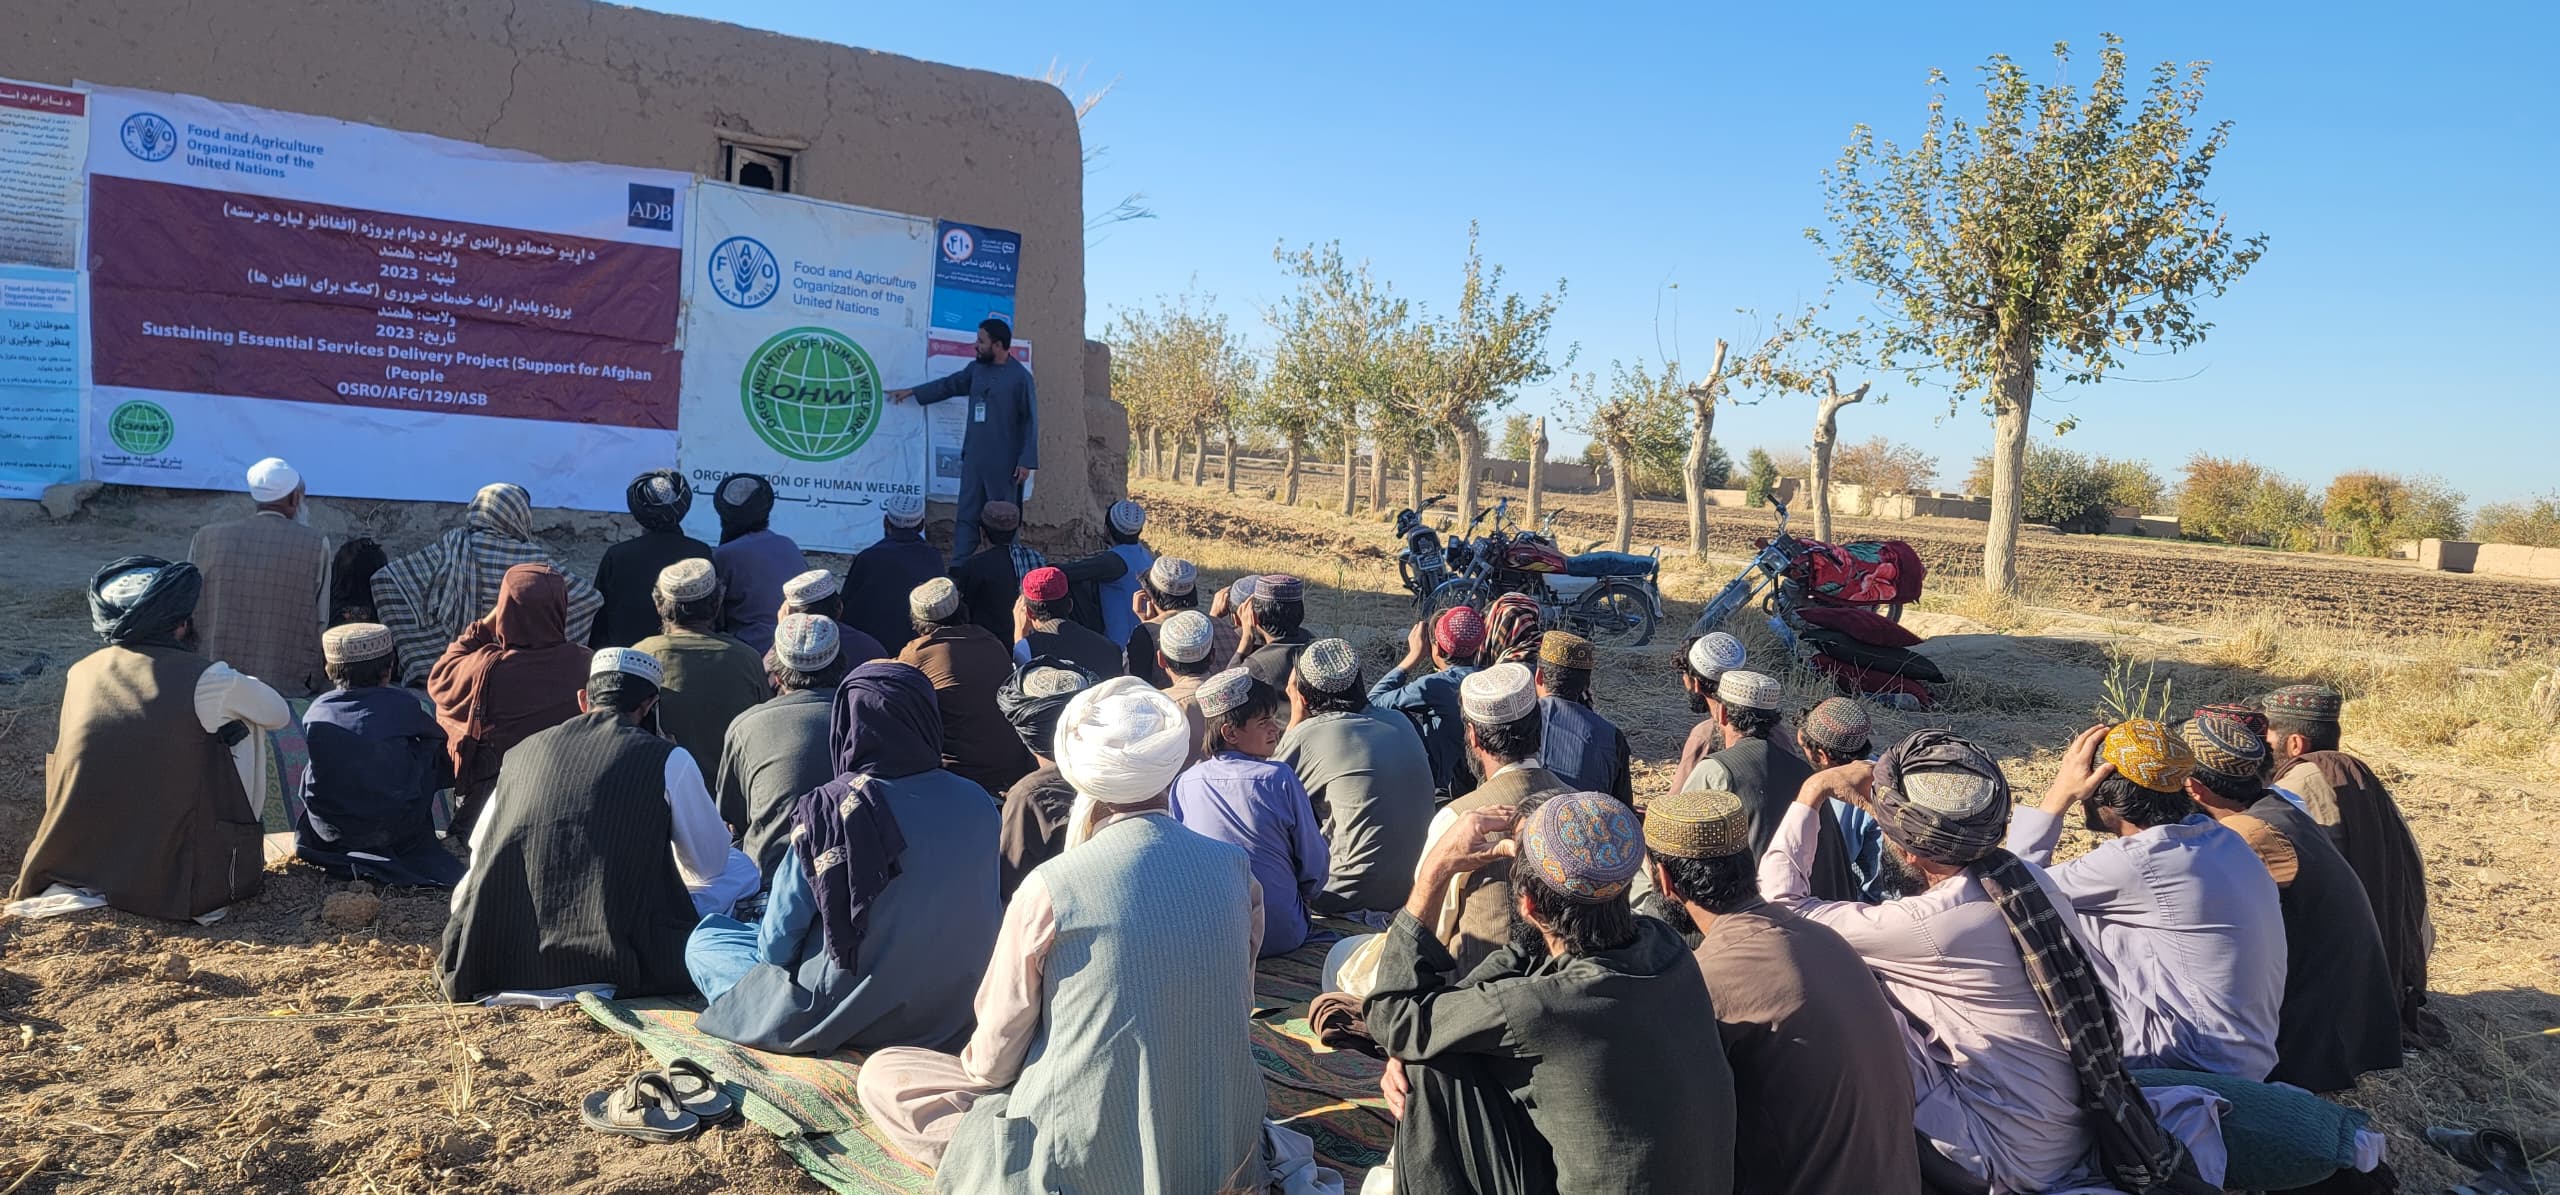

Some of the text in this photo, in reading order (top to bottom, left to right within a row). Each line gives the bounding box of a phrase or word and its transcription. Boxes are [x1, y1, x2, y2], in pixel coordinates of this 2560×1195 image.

[187, 123, 324, 156] Food and Agriculture
[187, 139, 314, 169] Organization of the
[187, 154, 286, 178] United Nations
[630, 200, 672, 221] ADB
[361, 221, 394, 241] پروژه
[398, 226, 426, 242] دوام
[429, 232, 437, 242] د
[379, 245, 415, 260] هلمند
[515, 239, 555, 257] خدماتو
[588, 252, 596, 261] د
[716, 243, 773, 279] FAO
[271, 273, 306, 288] افغان
[380, 264, 418, 280] 2023
[793, 260, 825, 277] Food
[829, 267, 852, 280] and
[855, 269, 917, 290] Agriculture
[310, 278, 339, 294] برای
[384, 287, 428, 303] ضروری
[715, 278, 773, 303] FIAT PANIS
[793, 277, 905, 304] Organization of the
[431, 289, 474, 306] خدمات
[506, 298, 539, 317] پایدار
[793, 293, 880, 317] United Nations
[377, 305, 414, 320] هلمند
[542, 304, 572, 320] پروژه
[376, 324, 456, 346] تاریخ: 2023
[142, 321, 652, 383] Sustaining Essential Services Delivery Project (Support for Afghan
[385, 365, 445, 384] (People
[337, 381, 488, 406] OSRO/AFG/129/ASB
[752, 338, 871, 436] ORGANIZATION OF HUMAN WELFARE
[769, 384, 855, 405] OHW
[794, 476, 811, 488] OF
[814, 478, 862, 492] HUMAN
[865, 481, 921, 496] WELFARE
